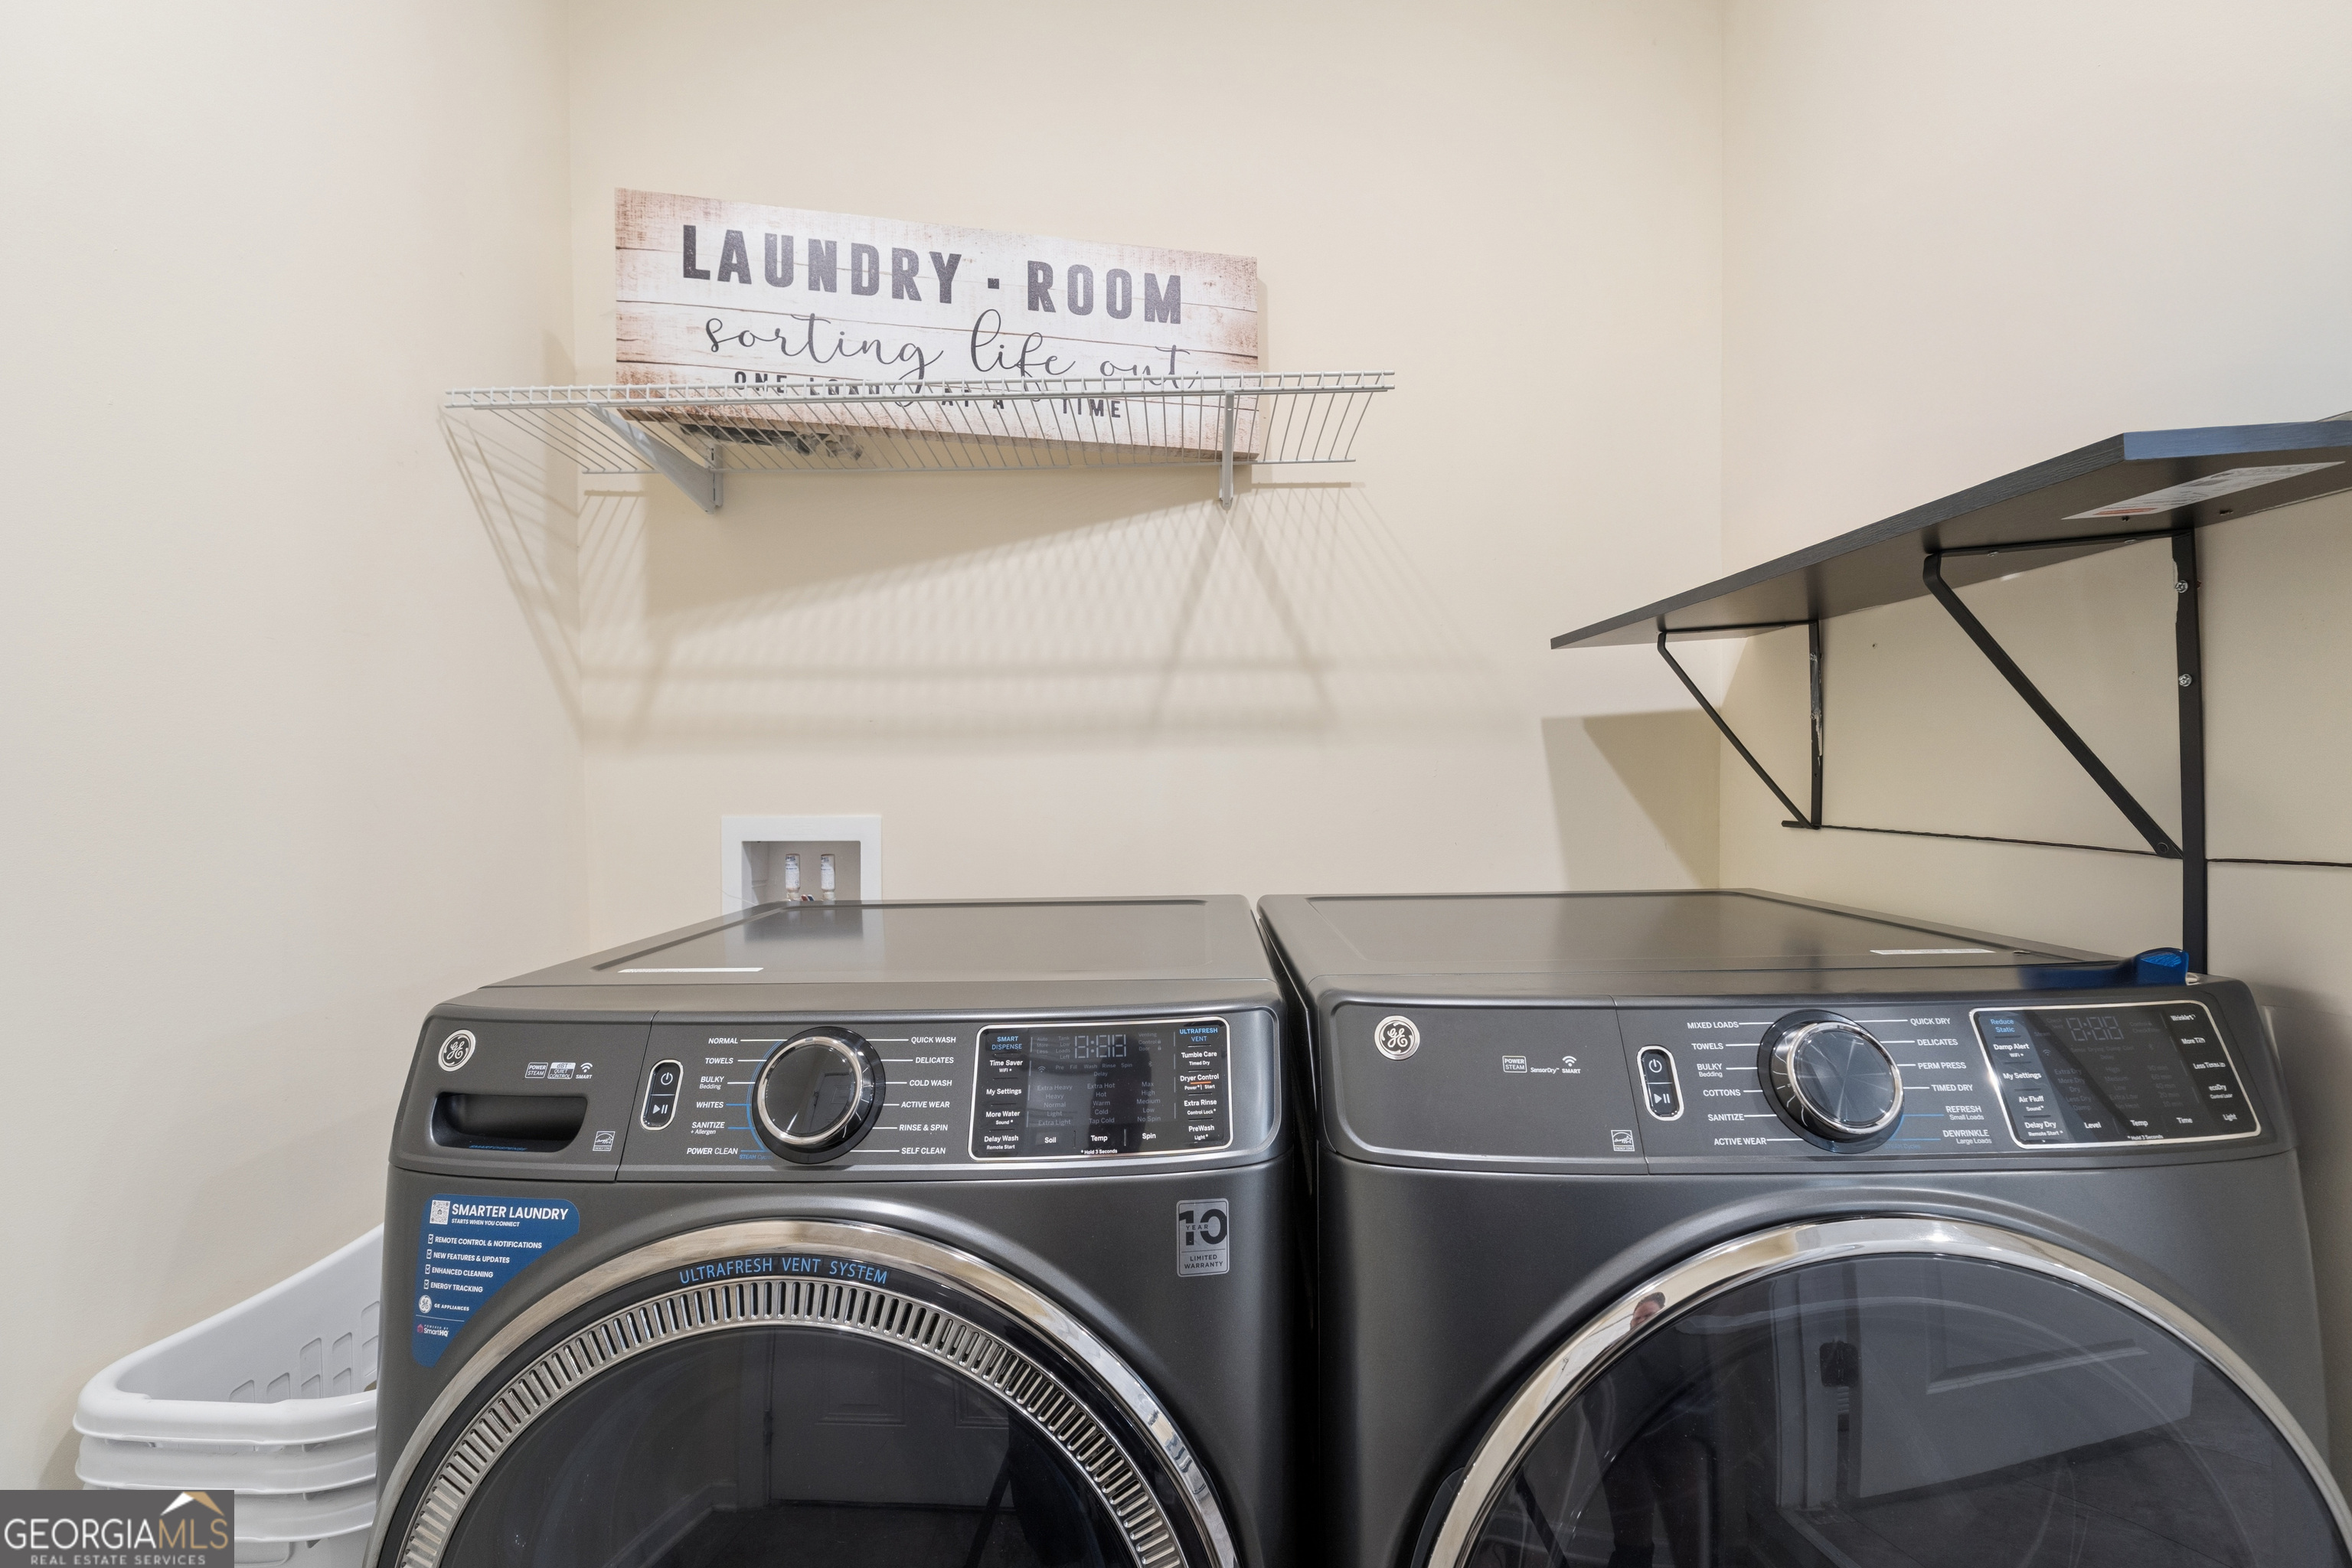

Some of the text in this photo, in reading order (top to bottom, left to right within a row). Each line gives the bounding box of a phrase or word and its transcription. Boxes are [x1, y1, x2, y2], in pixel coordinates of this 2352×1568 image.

[682, 224, 1182, 325] LAUNDRY ROOM
[704, 312, 943, 407] sorting
[970, 309, 1076, 402] life
[735, 371, 787, 394] ONE
[1060, 397, 1121, 418] TIME
[1910, 1018, 1935, 1026] QUICK
[452, 1204, 568, 1220] SMARTER LAUNDRY
[1179, 1209, 1227, 1246] 10
[458, 1238, 486, 1246] CONTROL
[493, 1241, 542, 1249] NOTIFICATIONS
[447, 1253, 475, 1262] FEATURES
[432, 1267, 493, 1278] ENHANCED CLEANING
[679, 1257, 888, 1284] ULTRAFRESH VENT SYSTEM
[453, 1284, 483, 1293] TRACKING
[424, 1328, 449, 1337] SmartHQ
